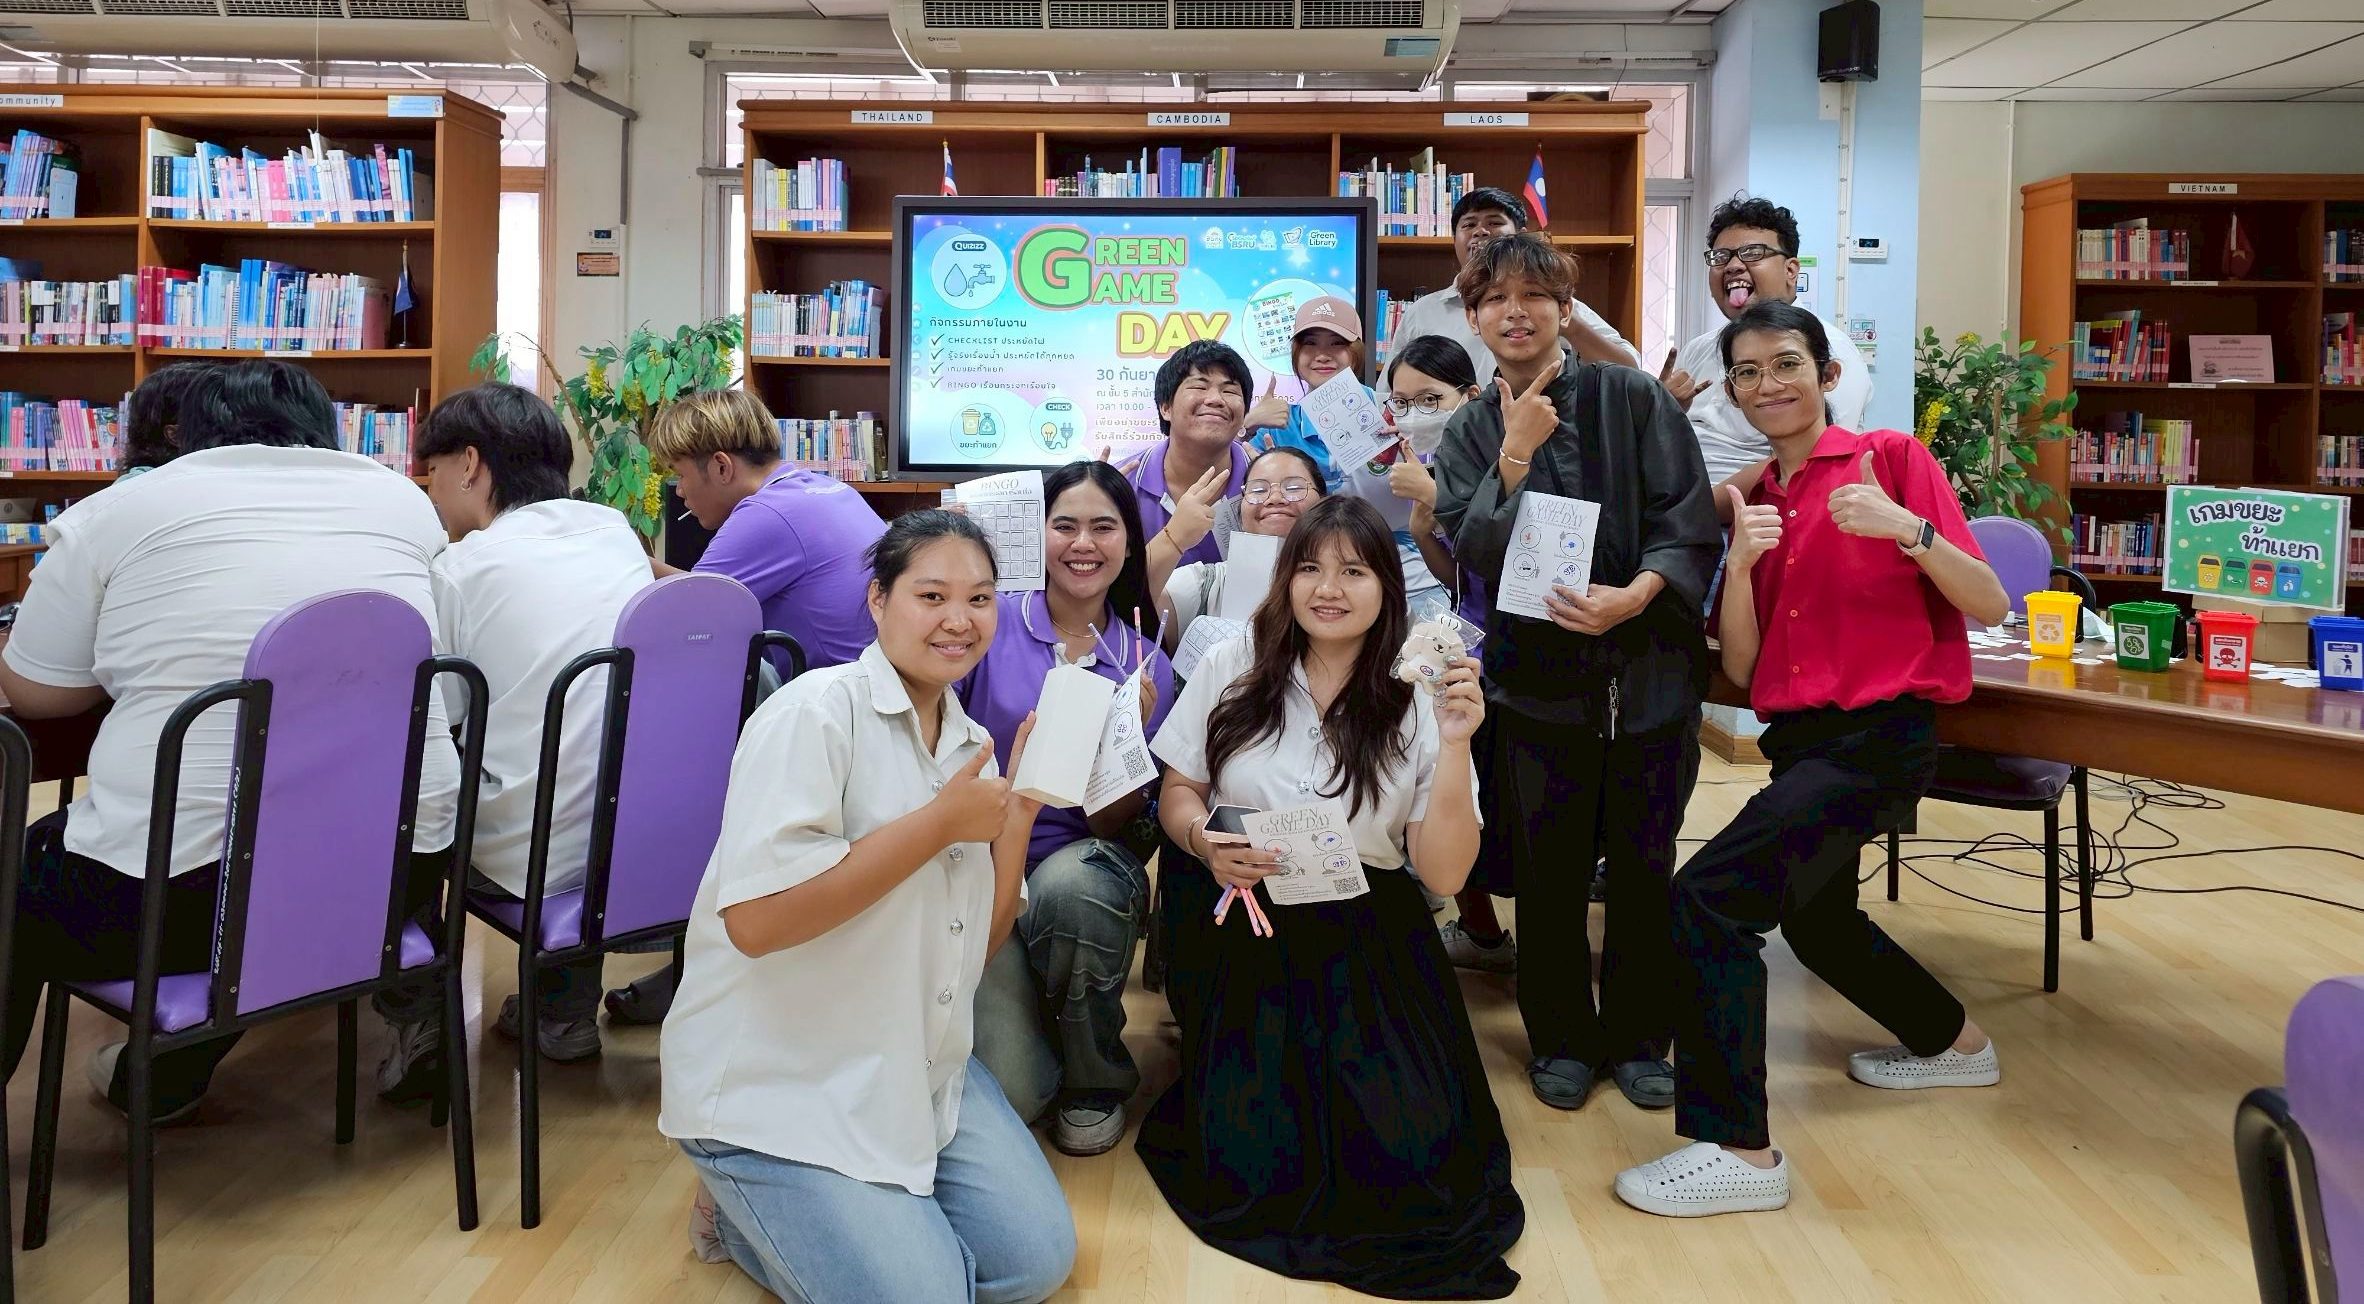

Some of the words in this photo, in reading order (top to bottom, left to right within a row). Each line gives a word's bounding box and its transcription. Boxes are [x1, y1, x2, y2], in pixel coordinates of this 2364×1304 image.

[861, 112, 923, 122] THAILAND
[1156, 114, 1222, 124] CAMBODIA
[1470, 115, 1503, 124] LAOS
[2180, 184, 2226, 193] VIETNAM
[1310, 231, 1335, 239] Green
[1309, 238, 1336, 248] Library
[929, 316, 1027, 328] กิจกรรมภายในงาน
[1119, 312, 1230, 355] DAY
[1001, 336, 1045, 345] ประหยัดไฟ
[1096, 369, 1114, 381] 30
[1123, 389, 1129, 397] 5
[1096, 403, 1116, 411] เวลา
[1120, 403, 1144, 411] 10.00
[960, 440, 997, 449] ขยะท้าแยก
[2189, 501, 2283, 524] เกมขยะ
[2241, 525, 2320, 560] ท้าแยก
